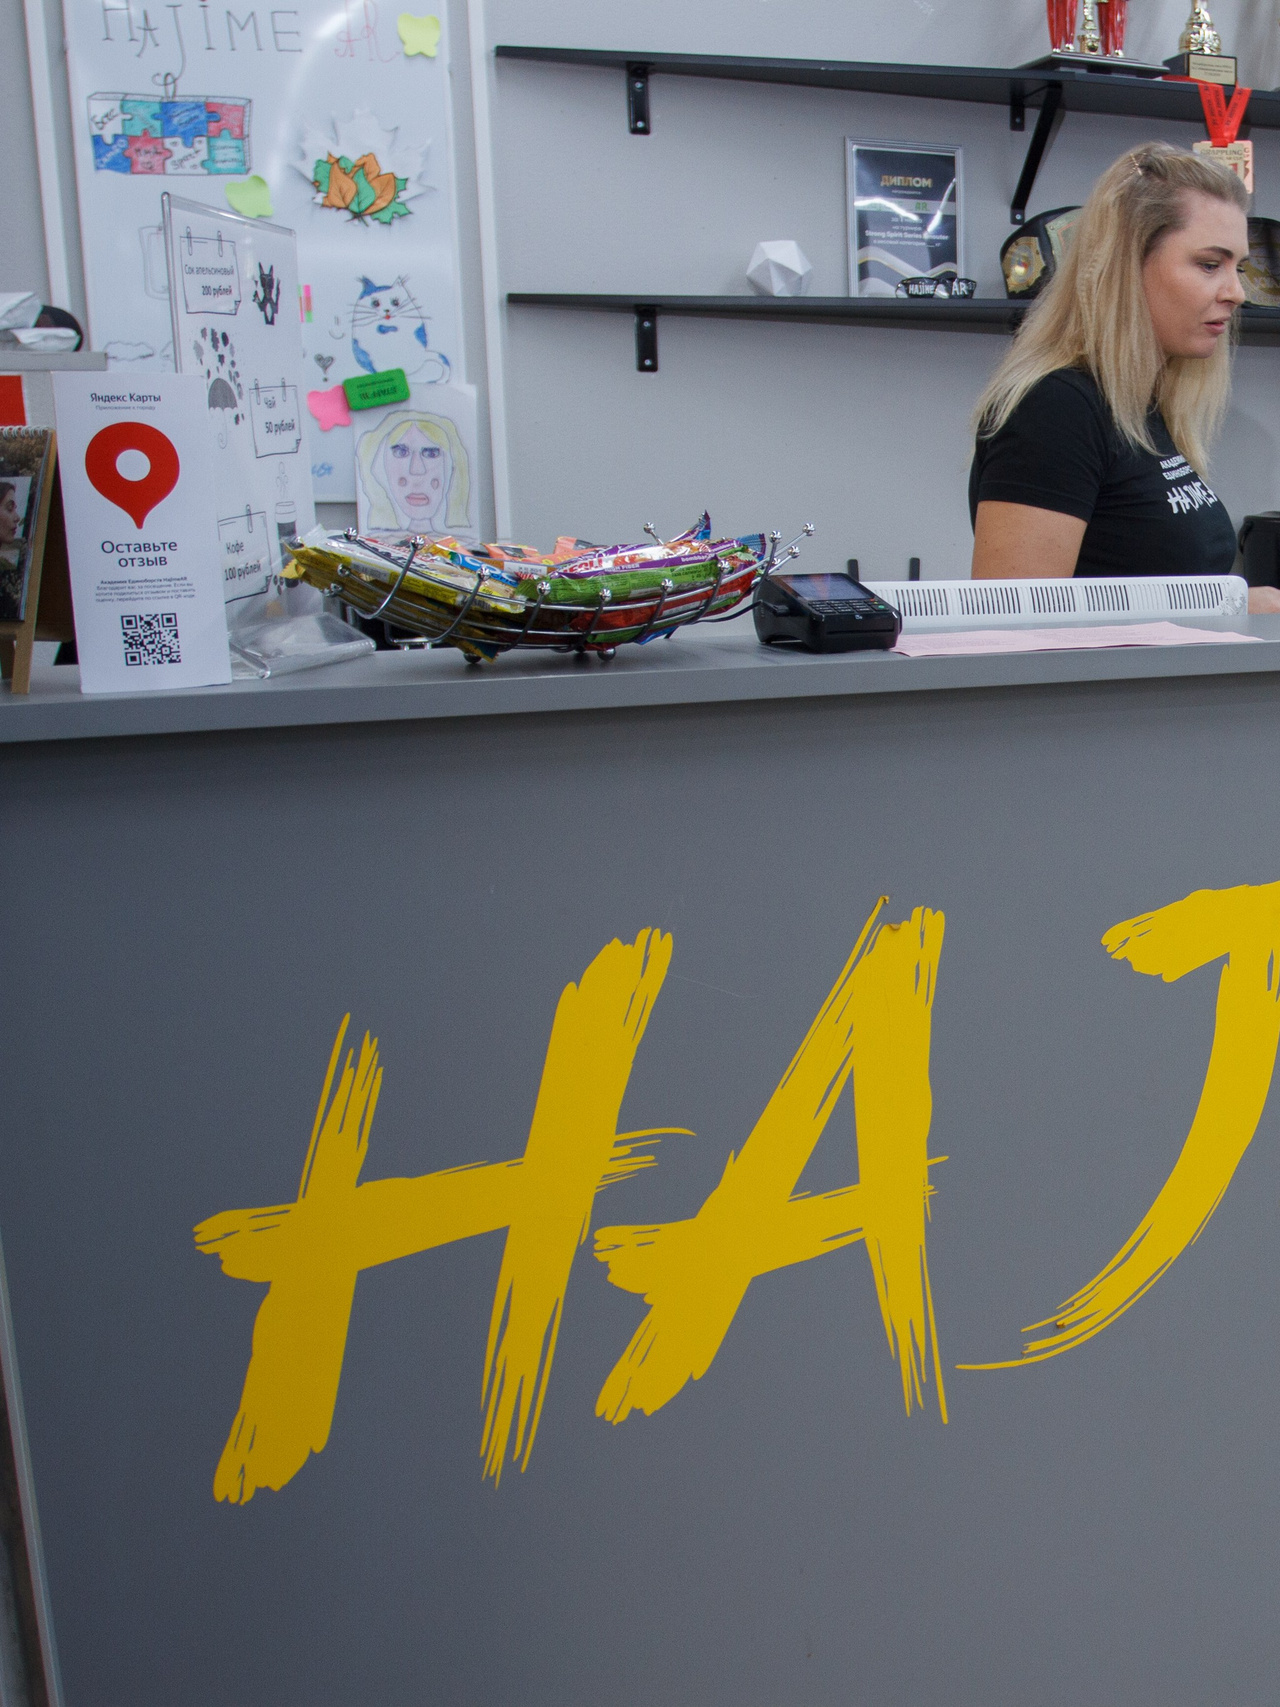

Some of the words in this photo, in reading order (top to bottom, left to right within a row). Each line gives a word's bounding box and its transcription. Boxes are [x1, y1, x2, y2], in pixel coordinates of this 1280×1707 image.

[881, 175, 933, 188] ДИПЛОМ
[185, 264, 195, 275] Сок
[202, 285, 211, 296] 200
[212, 285, 232, 298] рублей
[90, 393, 127, 403] Яндекс
[129, 393, 161, 403] Карты
[264, 396, 276, 409] Чай
[265, 423, 273, 434] 50
[274, 420, 295, 436] рублей
[101, 540, 178, 554] Оставьте
[226, 540, 244, 556] Кофе
[118, 556, 168, 568] отзыв
[224, 566, 238, 581] 100
[238, 561, 262, 580] рублей
